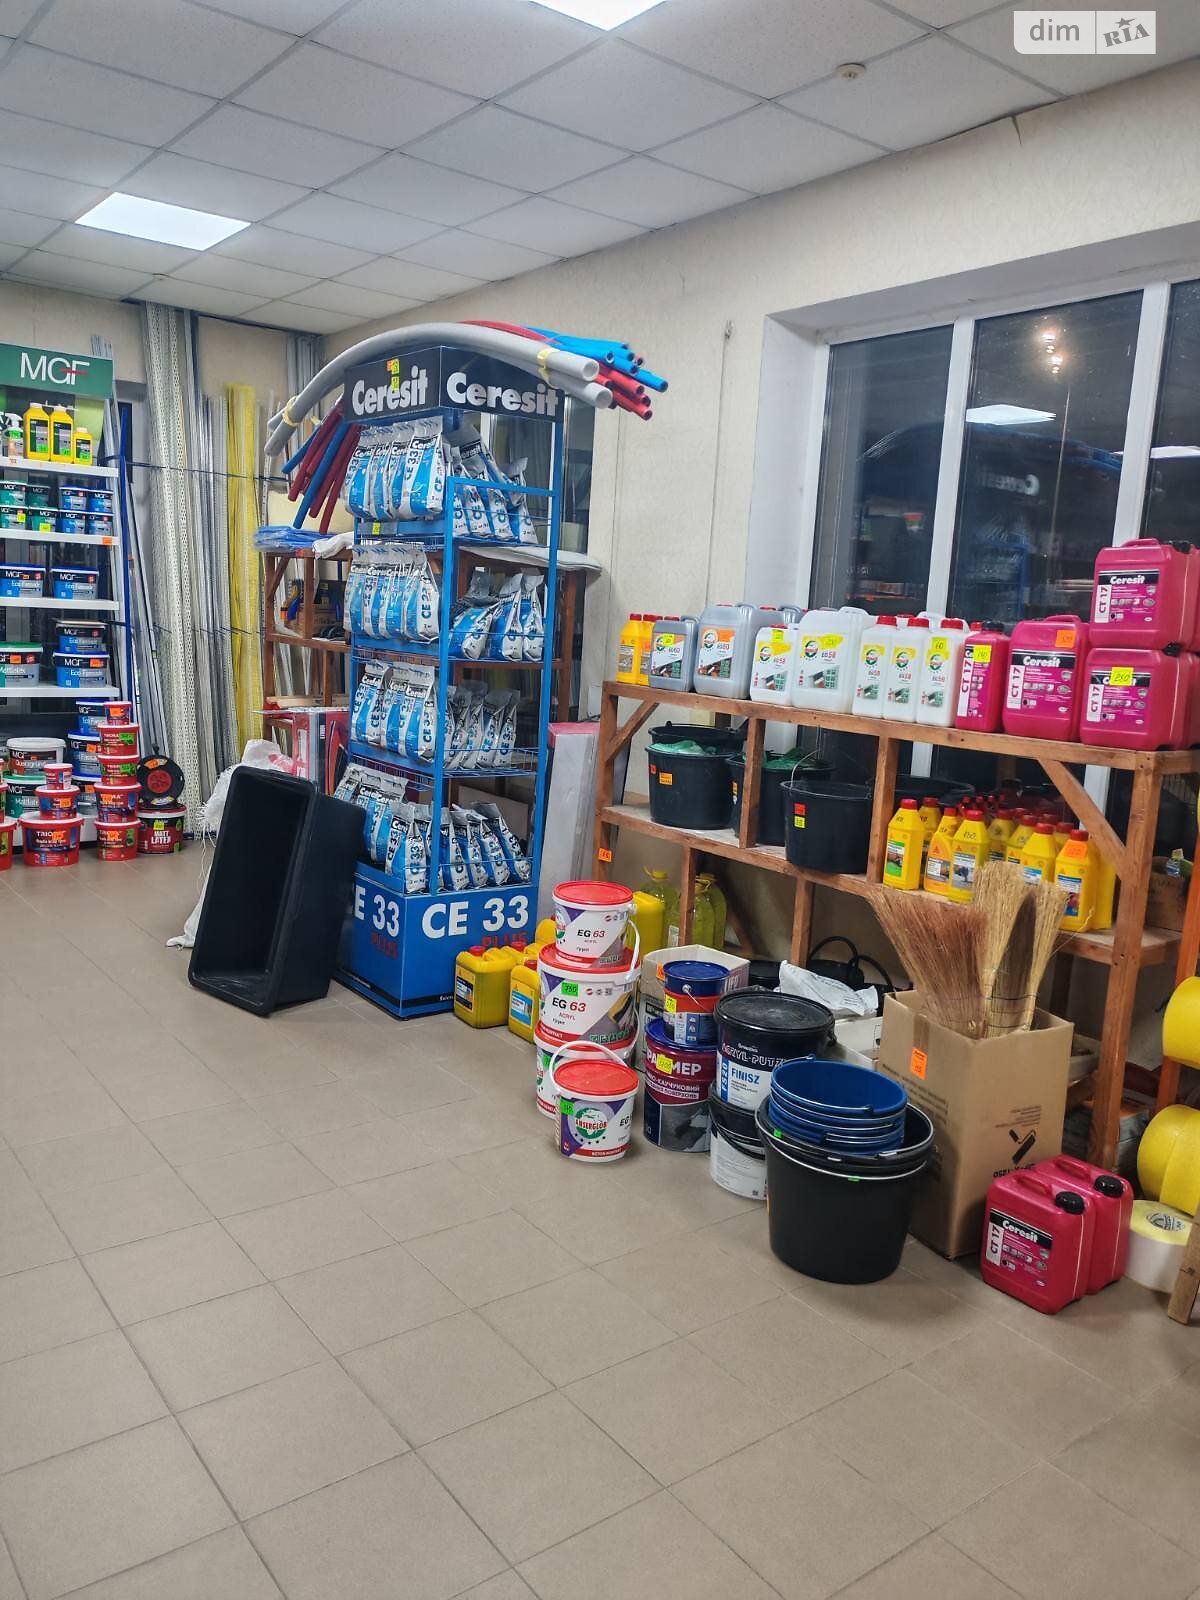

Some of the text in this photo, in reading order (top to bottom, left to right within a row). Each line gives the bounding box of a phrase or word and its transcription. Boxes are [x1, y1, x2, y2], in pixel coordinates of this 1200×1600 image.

[20, 352, 90, 385] MGF
[352, 366, 429, 415] Ceresit
[446, 371, 559, 416] Ceresit
[1110, 575, 1145, 584] Ceresit
[1098, 586, 1109, 613] CT 17
[1023, 656, 1061, 668] Ceresit
[1011, 683, 1019, 698] CT
[354, 885, 400, 937] E 33
[422, 895, 529, 939] CE 33
[577, 929, 606, 938] EG 63
[552, 997, 586, 1013] EG 63
[647, 1048, 702, 1076] РАМЕР
[731, 1067, 760, 1085] FINISZ
[1002, 1219, 1038, 1243] Ceresit
